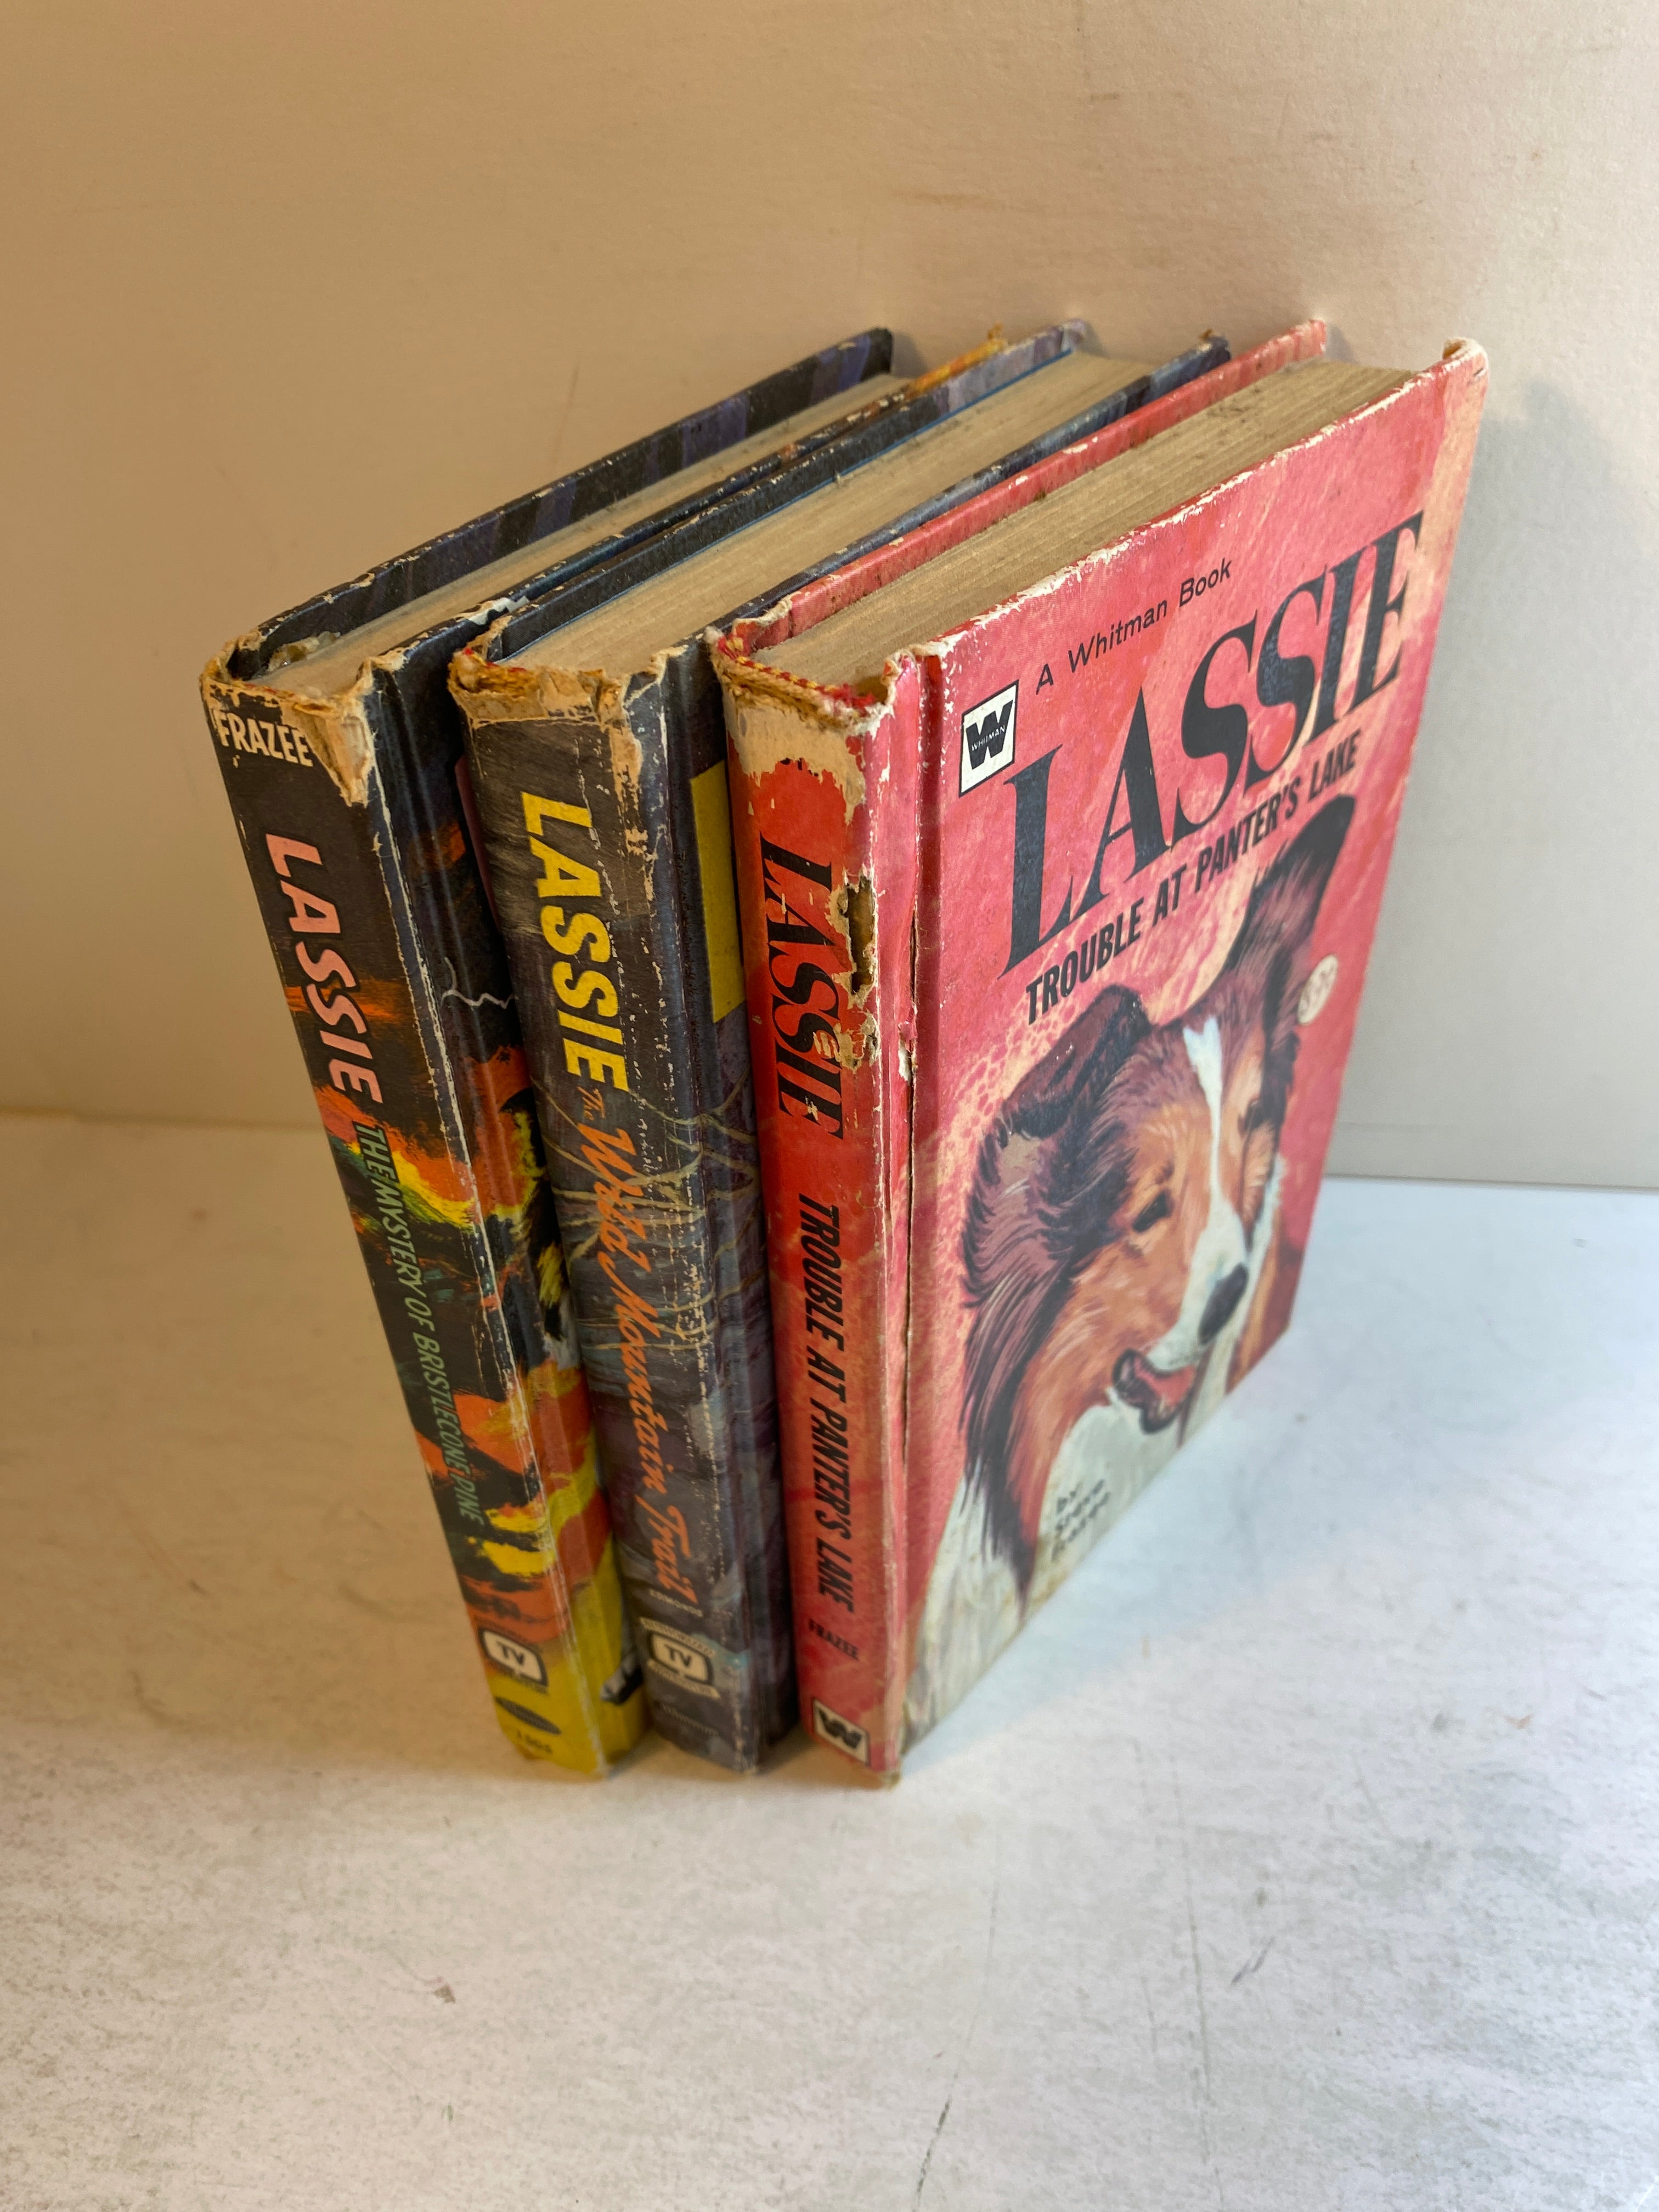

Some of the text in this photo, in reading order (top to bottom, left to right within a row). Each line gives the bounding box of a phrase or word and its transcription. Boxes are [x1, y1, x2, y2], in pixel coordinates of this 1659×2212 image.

[1036, 558, 1232, 695] A Whitman Book
[210, 707, 314, 767] FRAZEE
[998, 510, 1424, 979] LASSIE
[521, 792, 630, 1092] LASSIE
[1026, 729, 1362, 1025] TROUBLE AT PANTER'S LAKE
[266, 833, 383, 1104] LASSIE
[577, 1086, 606, 1121] The
[578, 1122, 652, 1273] Wild
[759, 830, 855, 1613] LASSIE TROUBLE AT PANTER'S LAKE
[356, 1124, 485, 1526] THE MYSTERY OF BRISTLECONE PINE
[597, 1251, 675, 1494] Mountain
[634, 1494, 698, 1604] Trail
[495, 1639, 525, 1667] TV
[664, 1644, 692, 1667] TV
[808, 1618, 860, 1661] FRAZEE
